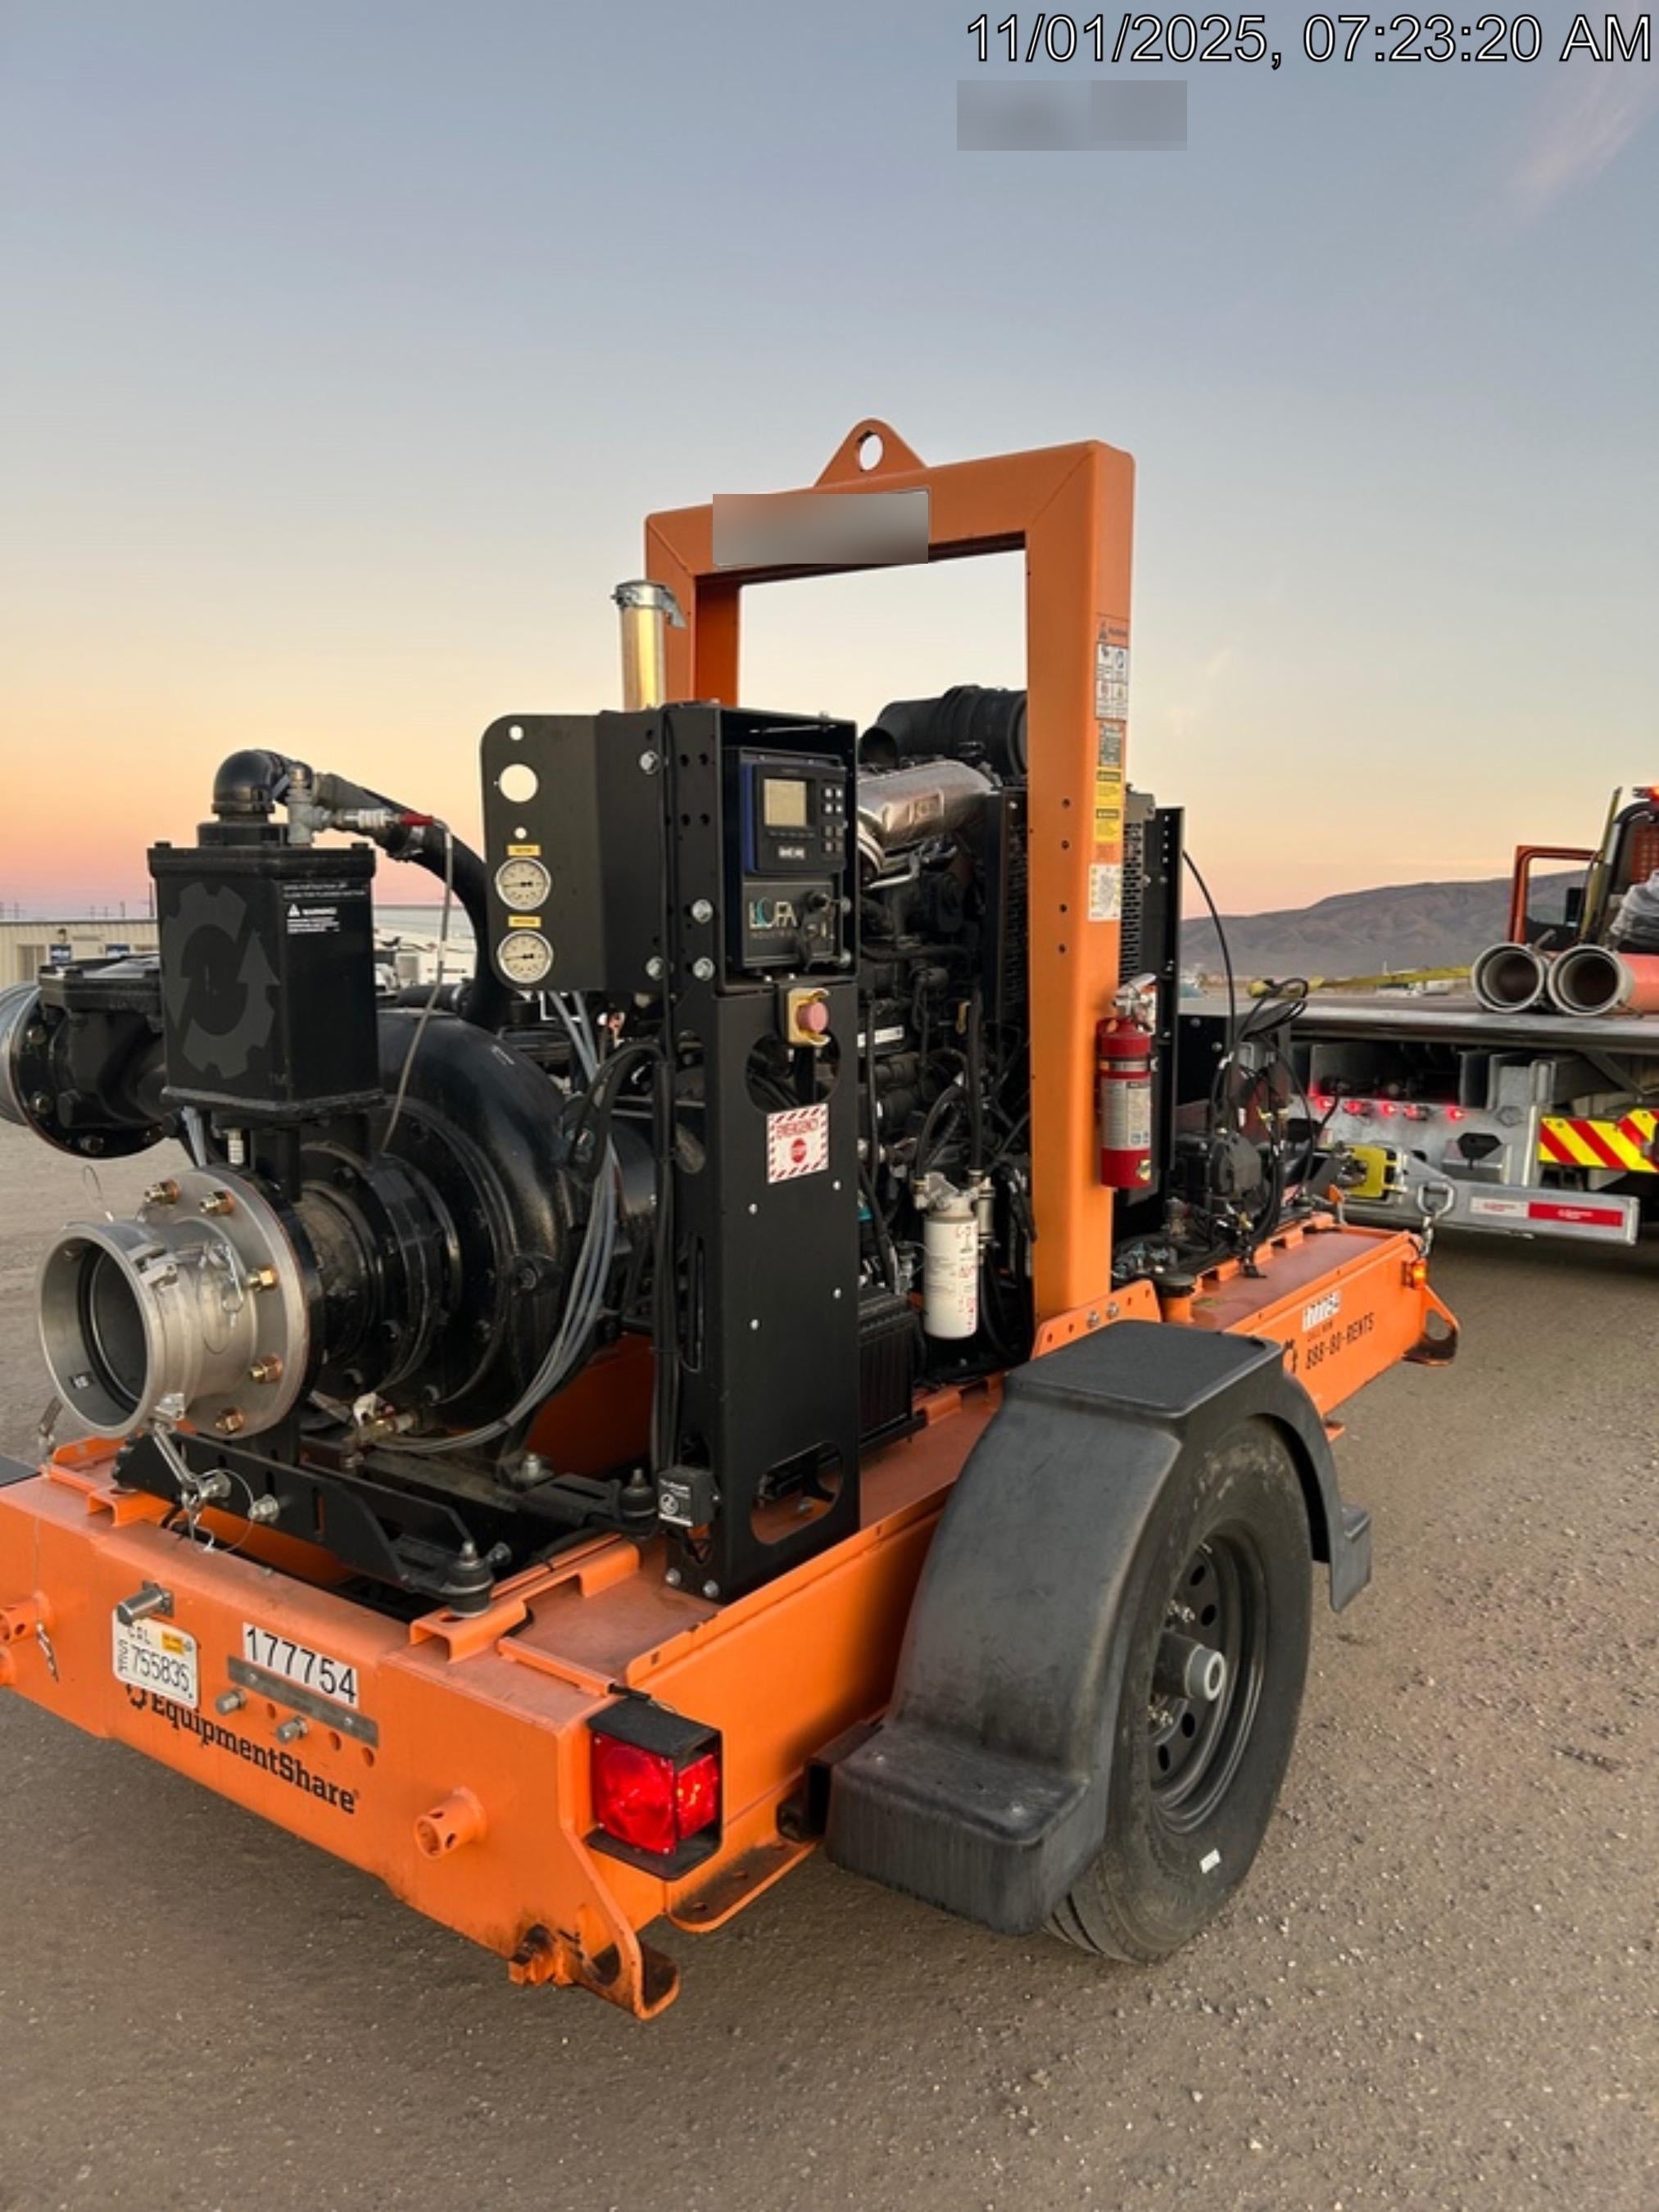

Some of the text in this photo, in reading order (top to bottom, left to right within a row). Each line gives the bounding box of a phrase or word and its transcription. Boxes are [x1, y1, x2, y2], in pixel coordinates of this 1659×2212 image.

[131, 1644, 189, 1692] 755835
[247, 1626, 356, 1704] 177754
[152, 1693, 355, 1815] EquipmentShare
